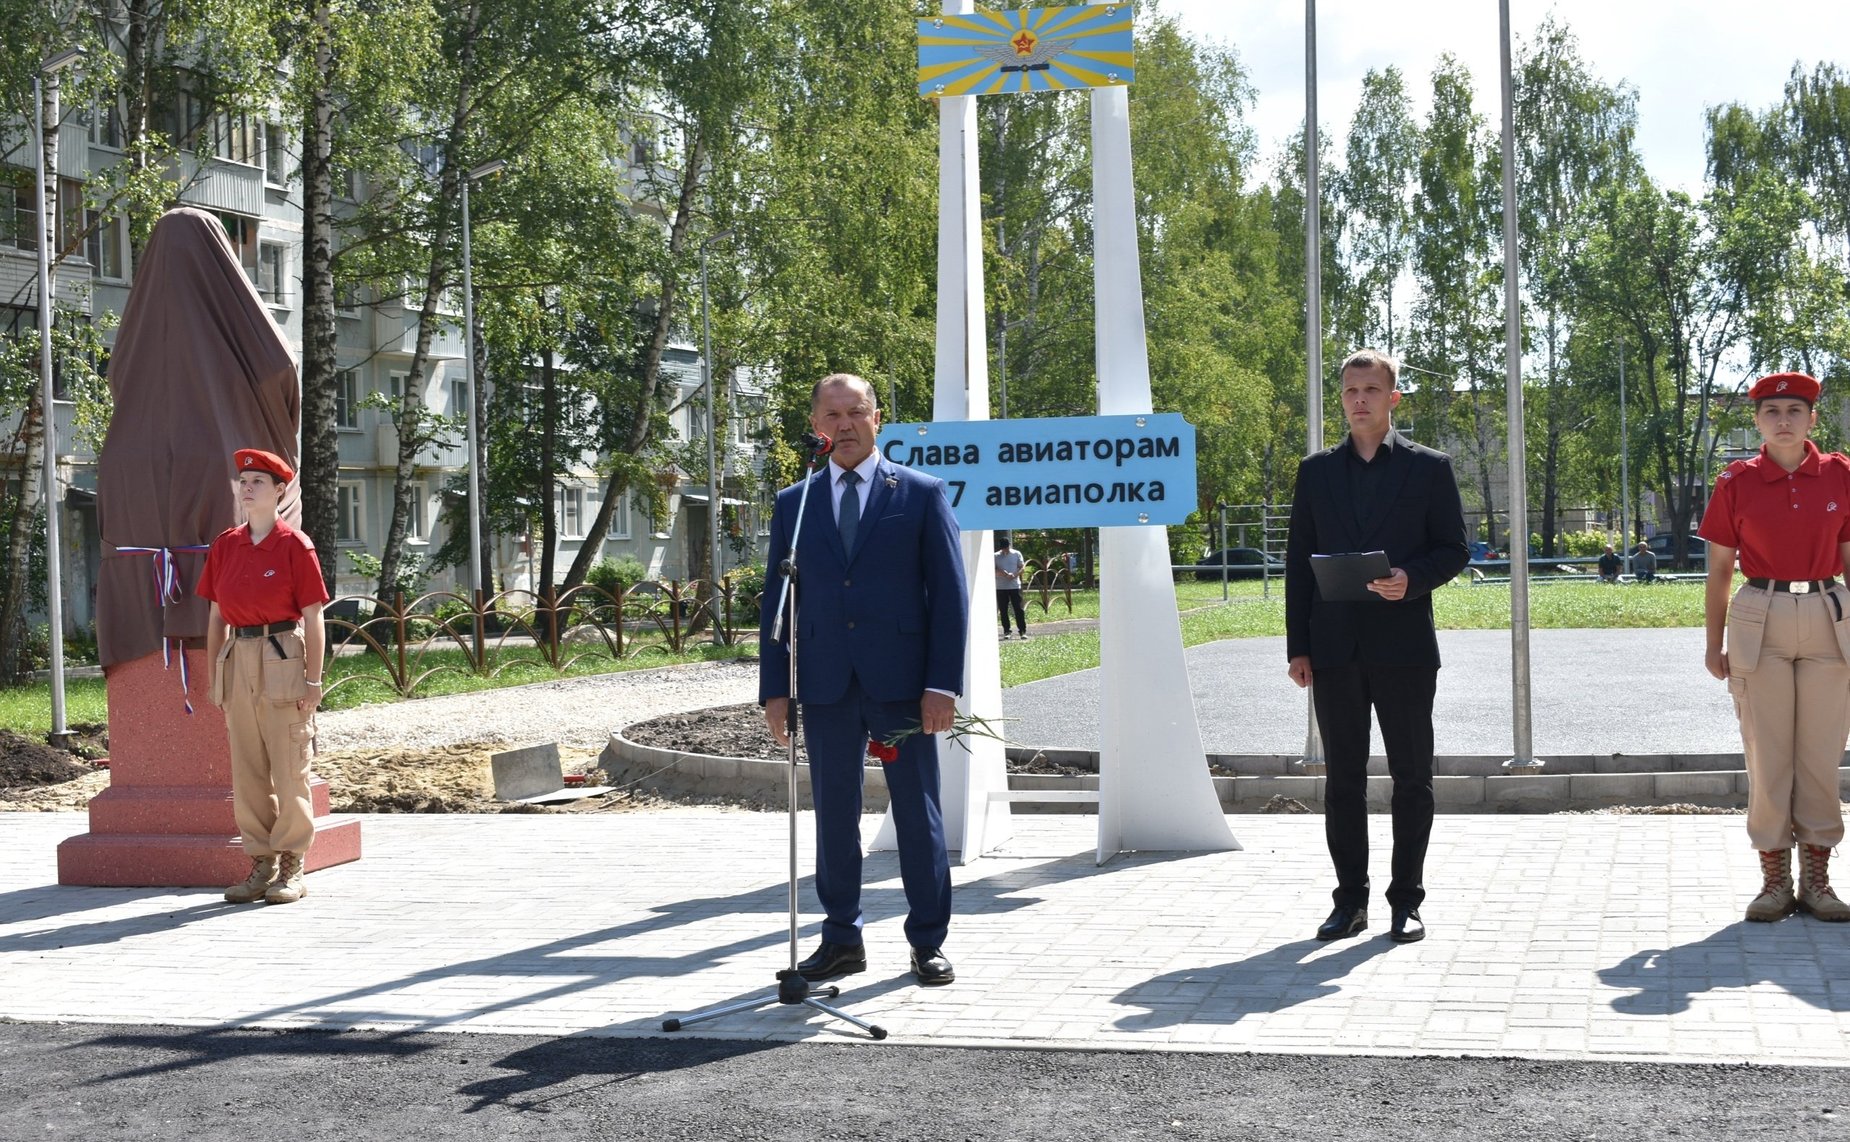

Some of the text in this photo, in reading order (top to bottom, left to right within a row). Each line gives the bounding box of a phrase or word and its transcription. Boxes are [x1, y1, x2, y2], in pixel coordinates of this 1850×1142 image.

[884, 436, 1180, 467] Слава авиаторам
[985, 480, 1165, 507] авиаполка
